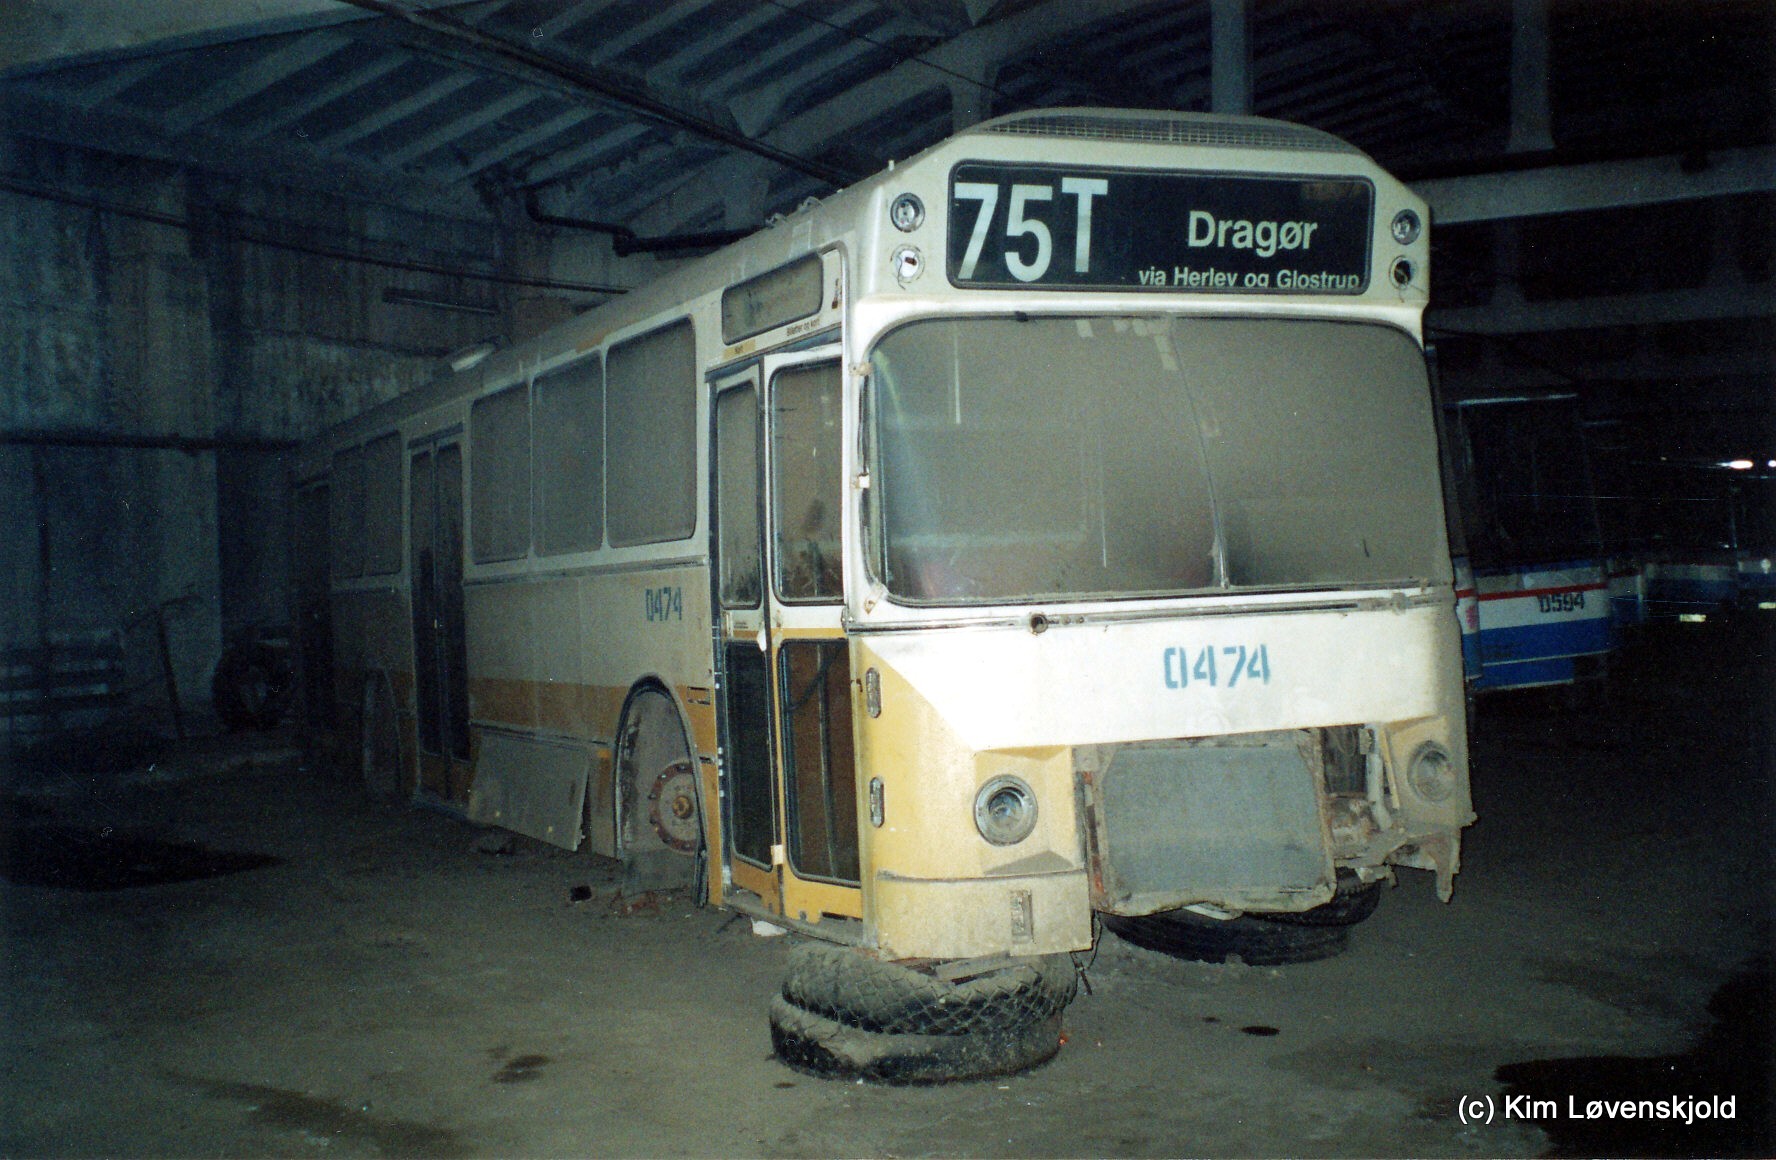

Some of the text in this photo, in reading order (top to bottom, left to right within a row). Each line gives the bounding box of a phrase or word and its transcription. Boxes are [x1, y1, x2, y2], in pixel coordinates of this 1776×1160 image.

[1188, 211, 1318, 258] Dragør
[1138, 266, 1166, 286] via
[1277, 269, 1360, 289] Glostrup
[646, 587, 682, 621] 0474
[1164, 643, 1271, 689] 0474
